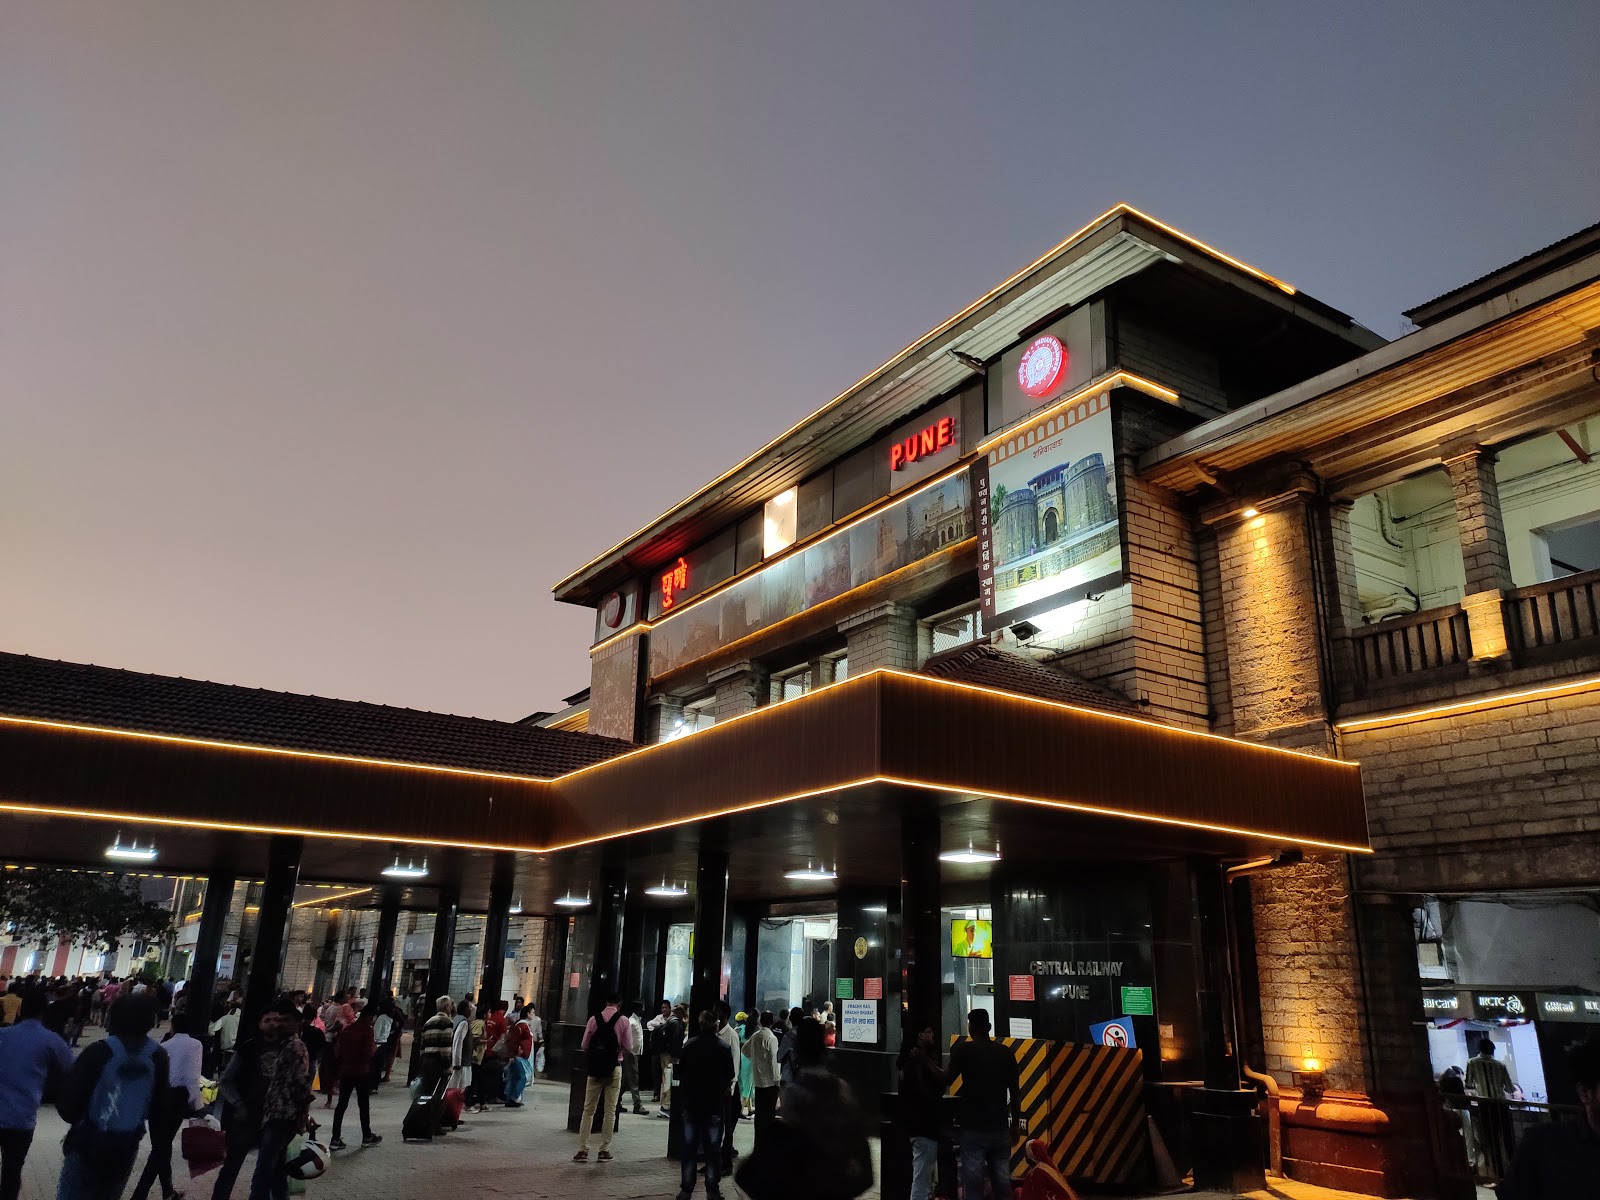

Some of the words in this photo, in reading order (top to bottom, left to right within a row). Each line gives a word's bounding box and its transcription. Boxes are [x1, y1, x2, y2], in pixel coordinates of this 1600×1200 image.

[890, 416, 953, 471] PUNE
[662, 557, 687, 608] पुणे
[1030, 961, 1076, 976] CENTRAL
[1077, 961, 1124, 977] RAILWAY
[1061, 984, 1090, 1000] PUNE
[1479, 996, 1505, 1007] IRCTC
